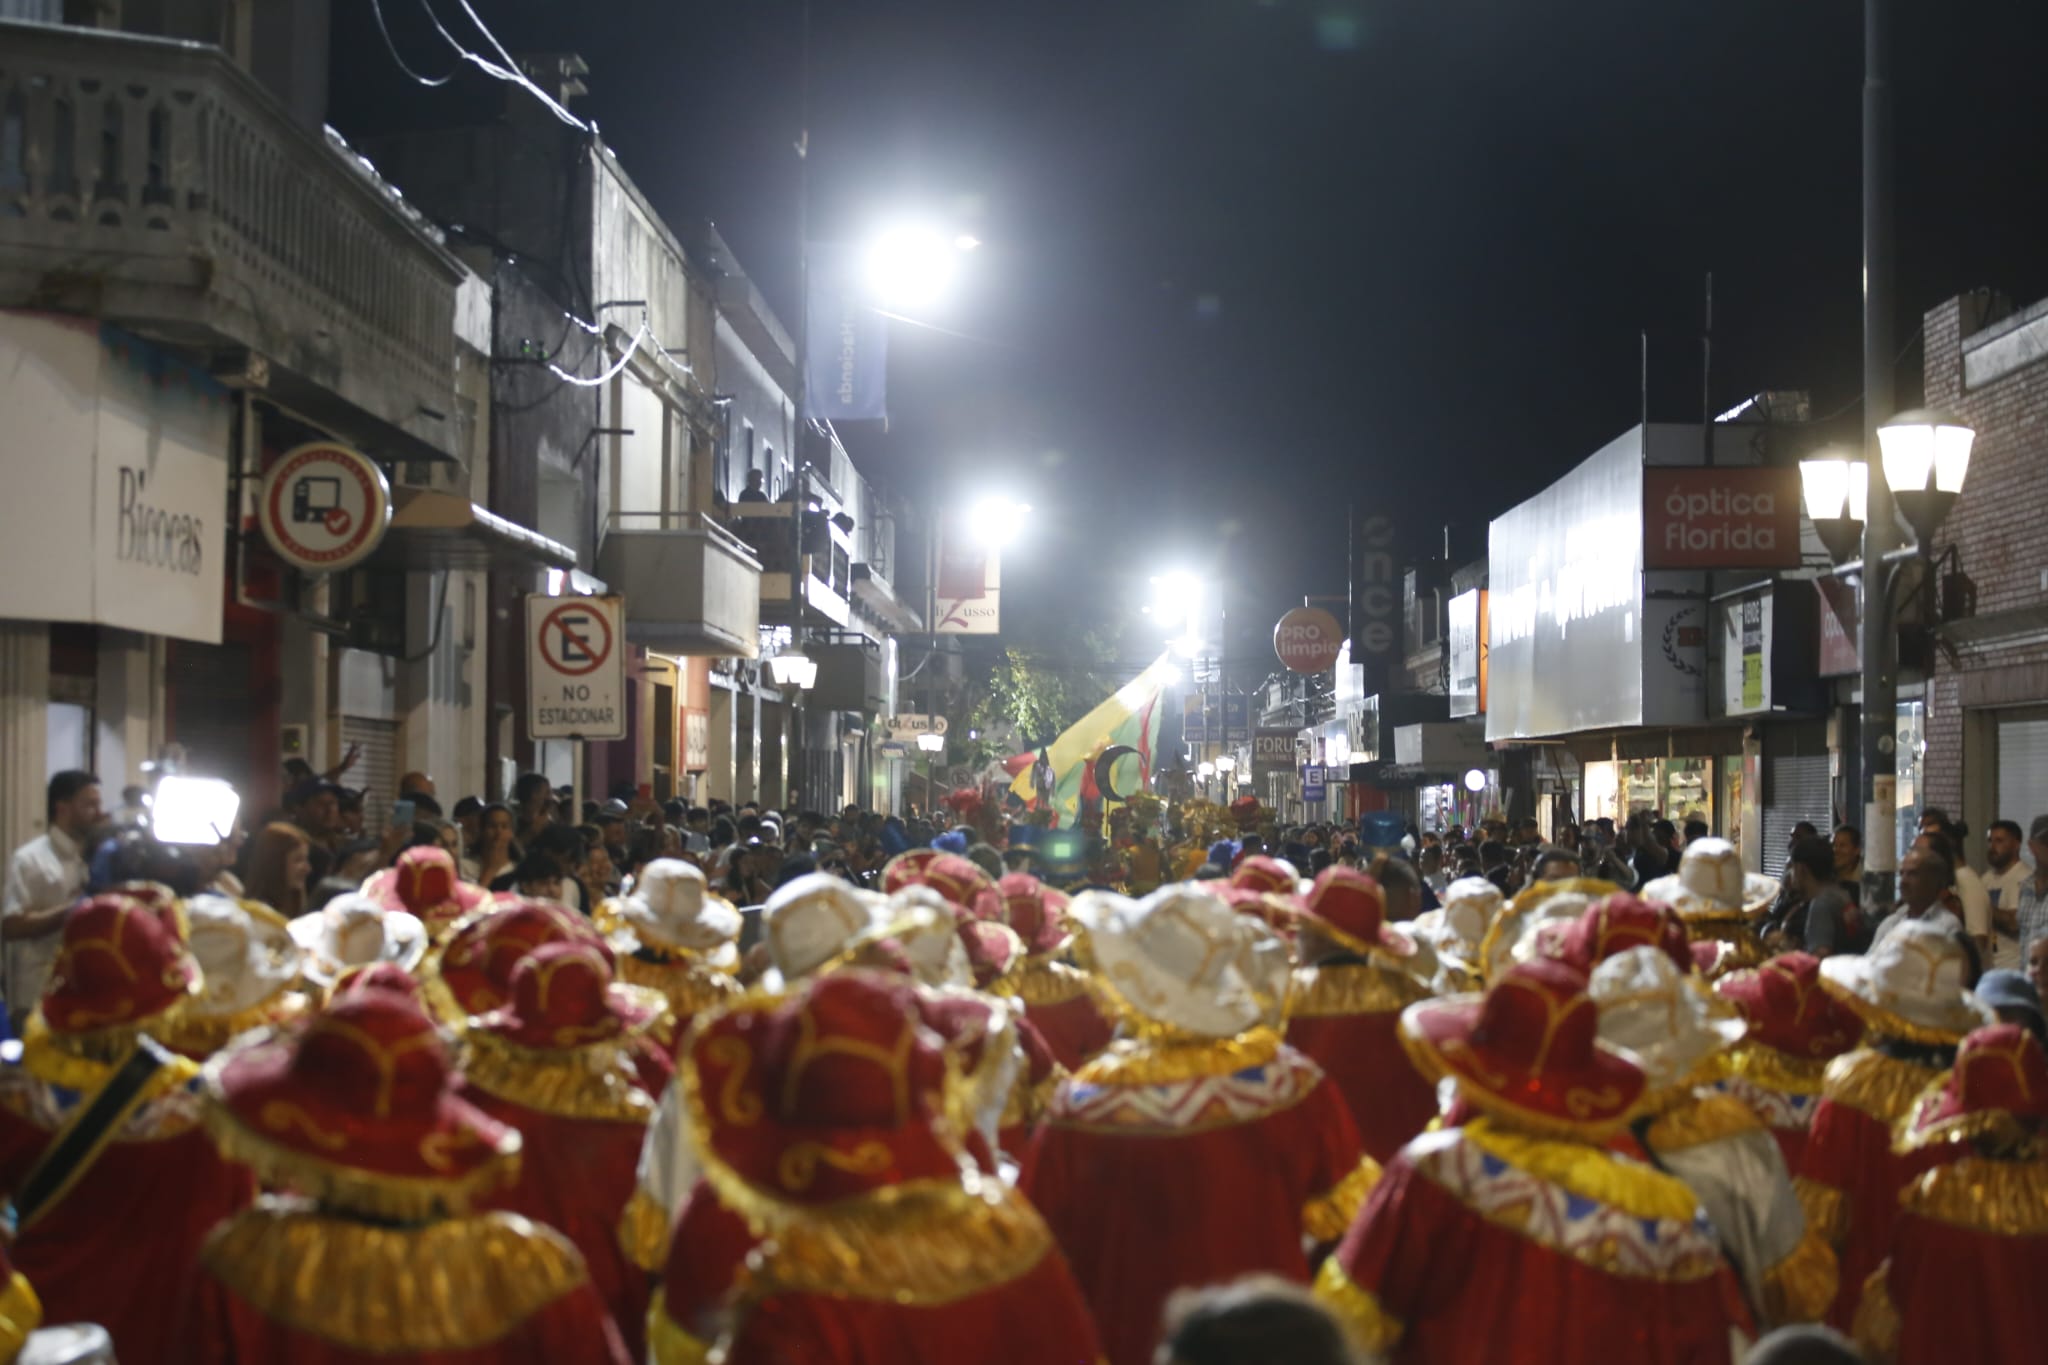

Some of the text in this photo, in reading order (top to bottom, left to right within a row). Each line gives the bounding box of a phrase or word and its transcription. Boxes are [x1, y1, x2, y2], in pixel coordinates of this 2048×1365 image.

[1665, 484, 1775, 521] óptica
[1362, 515, 1393, 653] once
[1280, 625, 1320, 640] PRO
[1281, 640, 1339, 658] limpio
[562, 685, 590, 701] NO
[539, 707, 614, 725] ESTACIONAR
[1256, 737, 1297, 753] FORU
[1310, 771, 1319, 784] E
